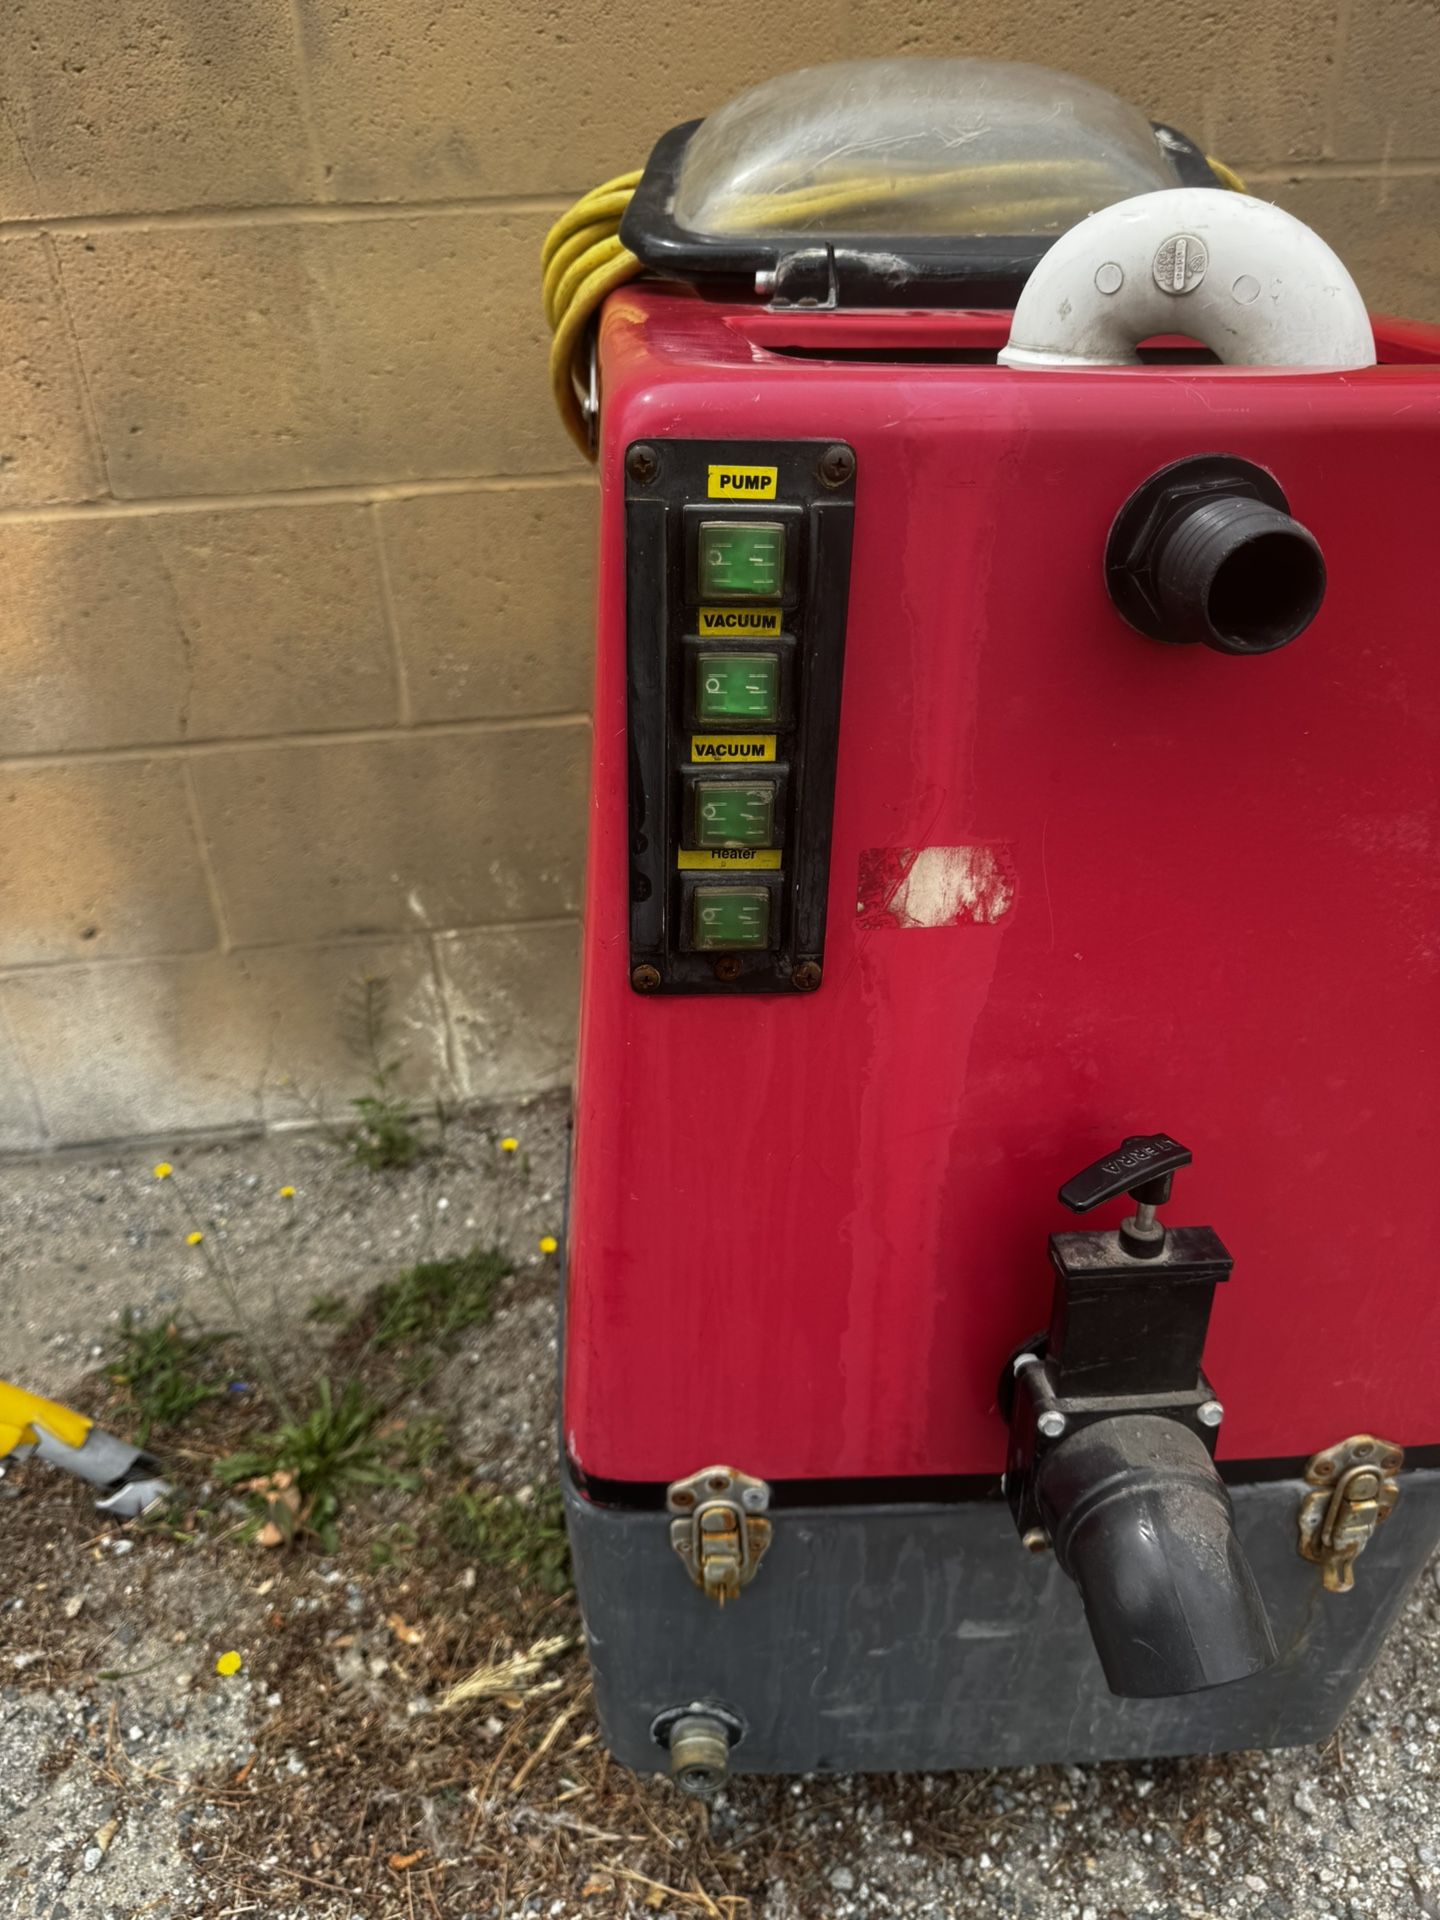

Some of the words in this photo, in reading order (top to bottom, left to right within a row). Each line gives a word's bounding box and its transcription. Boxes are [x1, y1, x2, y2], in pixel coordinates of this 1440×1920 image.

[720, 474, 772, 490] PUMP
[703, 614, 776, 629] VACUUM
[695, 744, 765, 757] VACUUM
[711, 848, 757, 860] Heater
